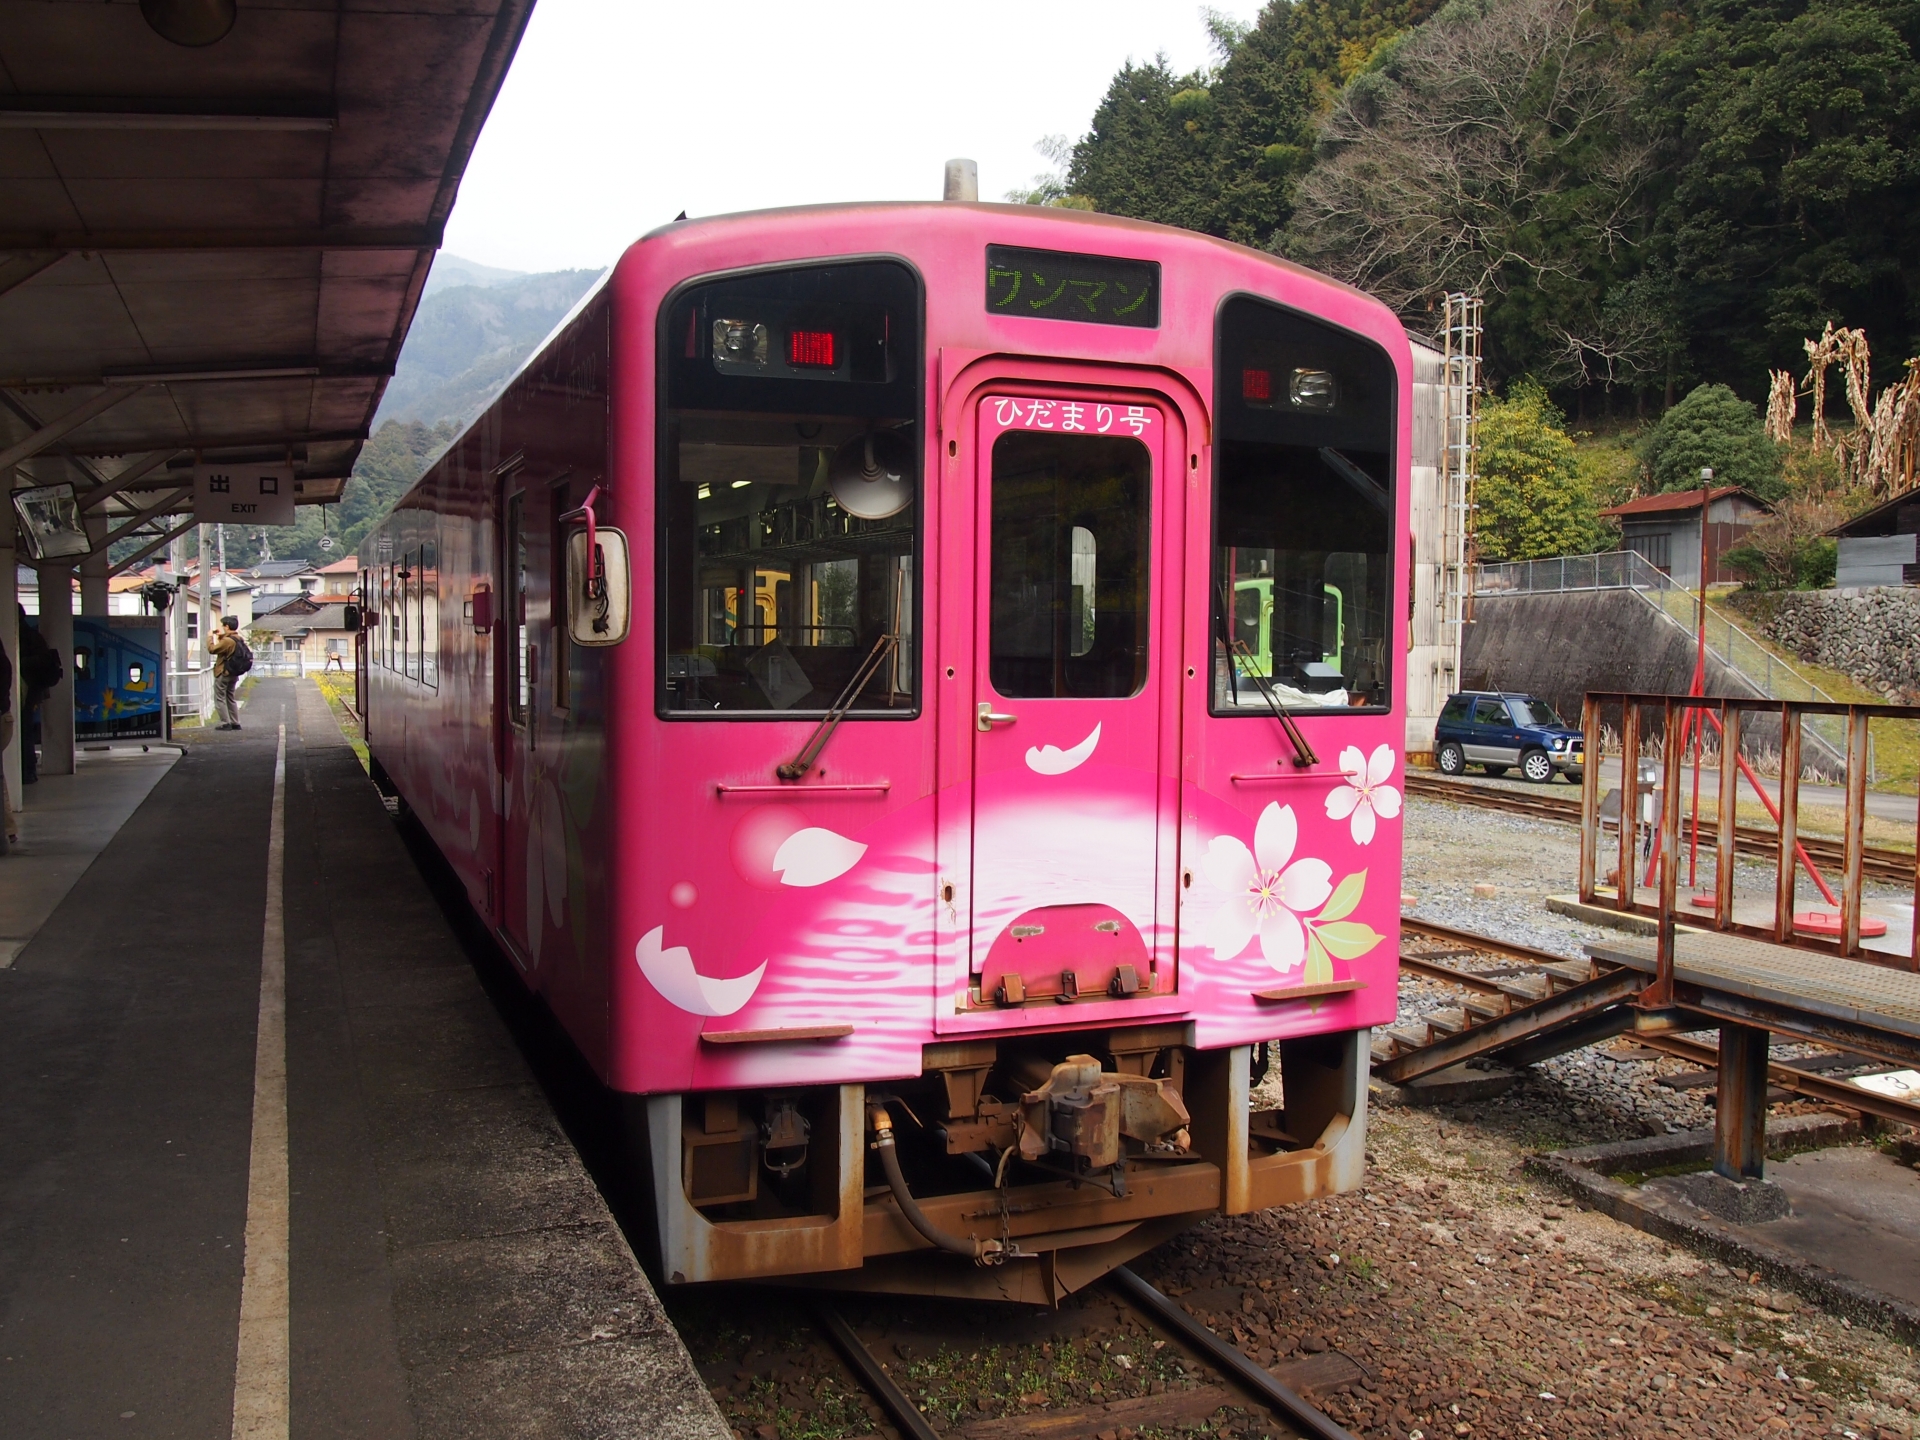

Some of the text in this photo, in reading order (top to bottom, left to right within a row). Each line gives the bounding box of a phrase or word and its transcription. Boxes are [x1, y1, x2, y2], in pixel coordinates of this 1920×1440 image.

[989, 268, 1148, 316] ワンマン
[994, 399, 1152, 436] ひだまり号
[209, 475, 279, 495] 出口
[231, 503, 258, 513] EXIT
[321, 538, 331, 548] 2
[1884, 1075, 1910, 1090] 3
